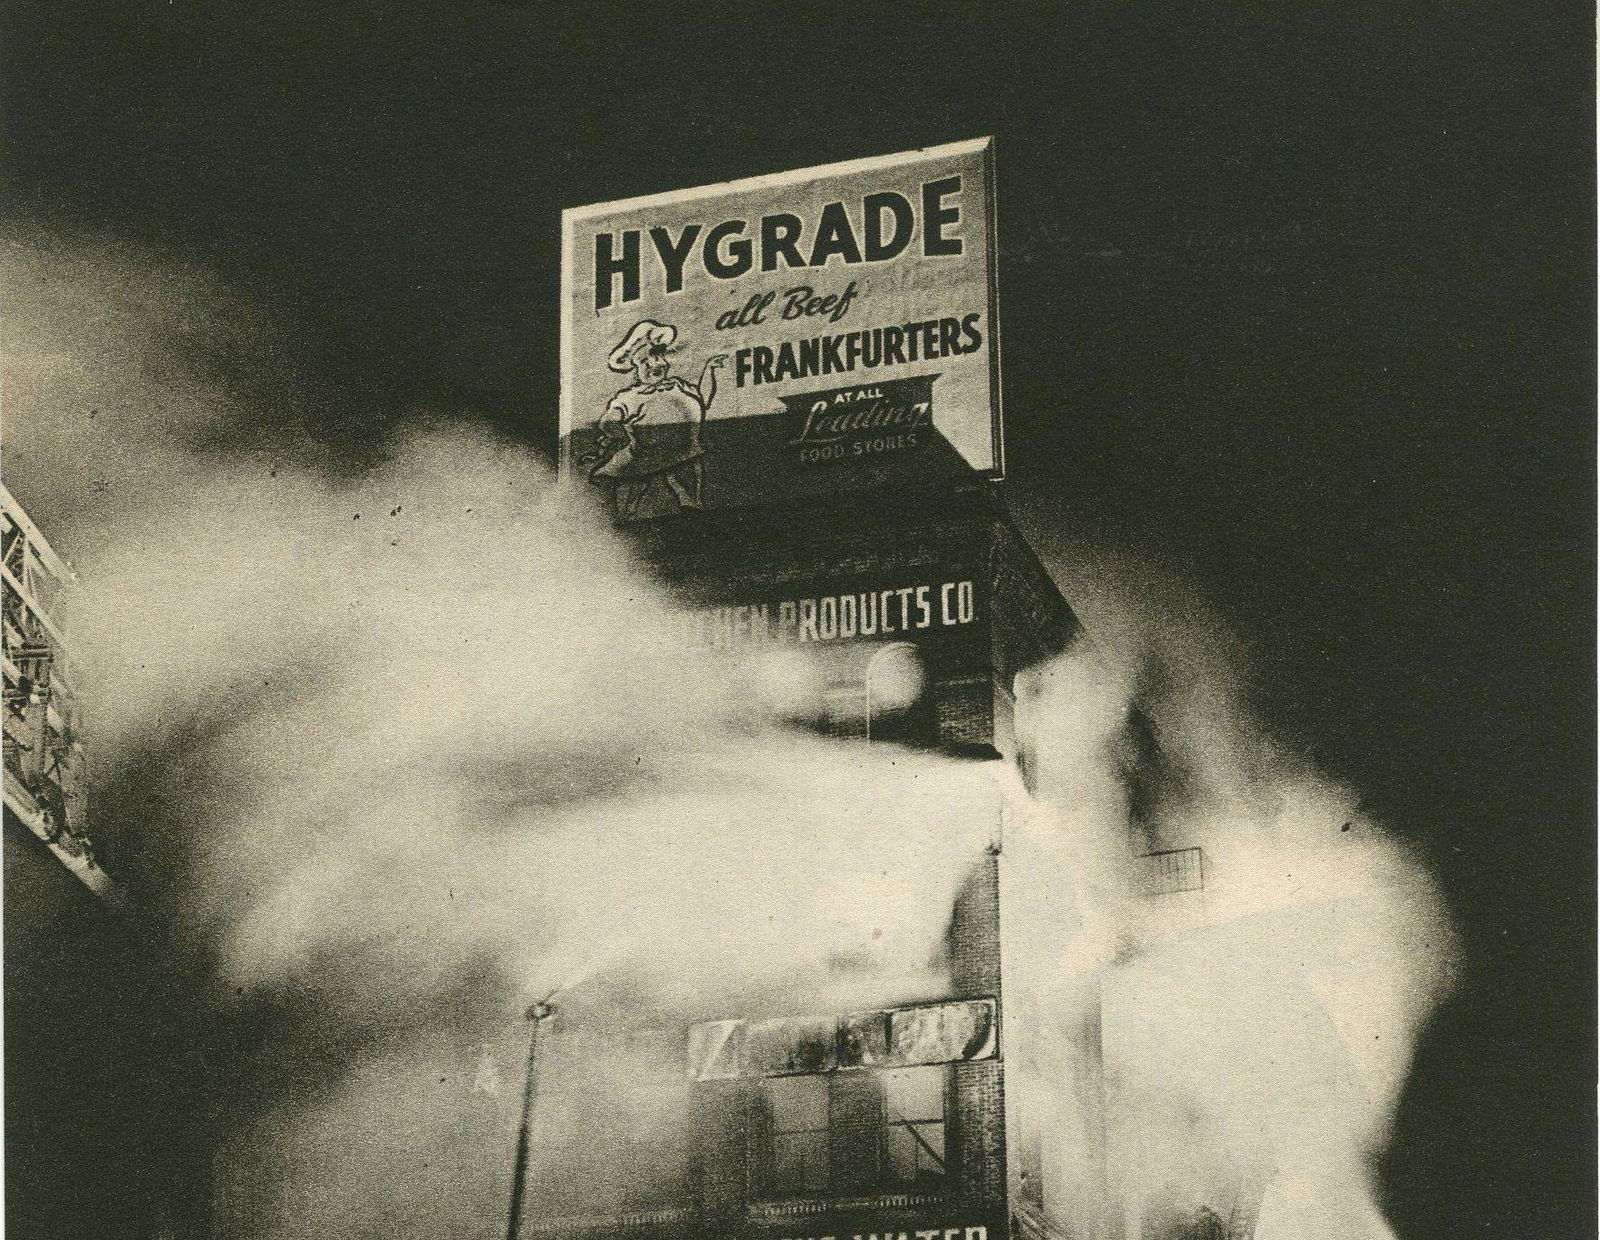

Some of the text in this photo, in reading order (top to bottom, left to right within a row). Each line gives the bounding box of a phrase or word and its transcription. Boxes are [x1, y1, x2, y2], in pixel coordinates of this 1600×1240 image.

[595, 175, 964, 312] HYGRADE
[714, 281, 858, 331] all Beef
[734, 312, 984, 388] FRANKFURTERS
[834, 387, 884, 405] AT ALL
[788, 398, 930, 445] Leading
[799, 433, 918, 463] FOOD STORES
[778, 586, 931, 645] PRODUCTS
